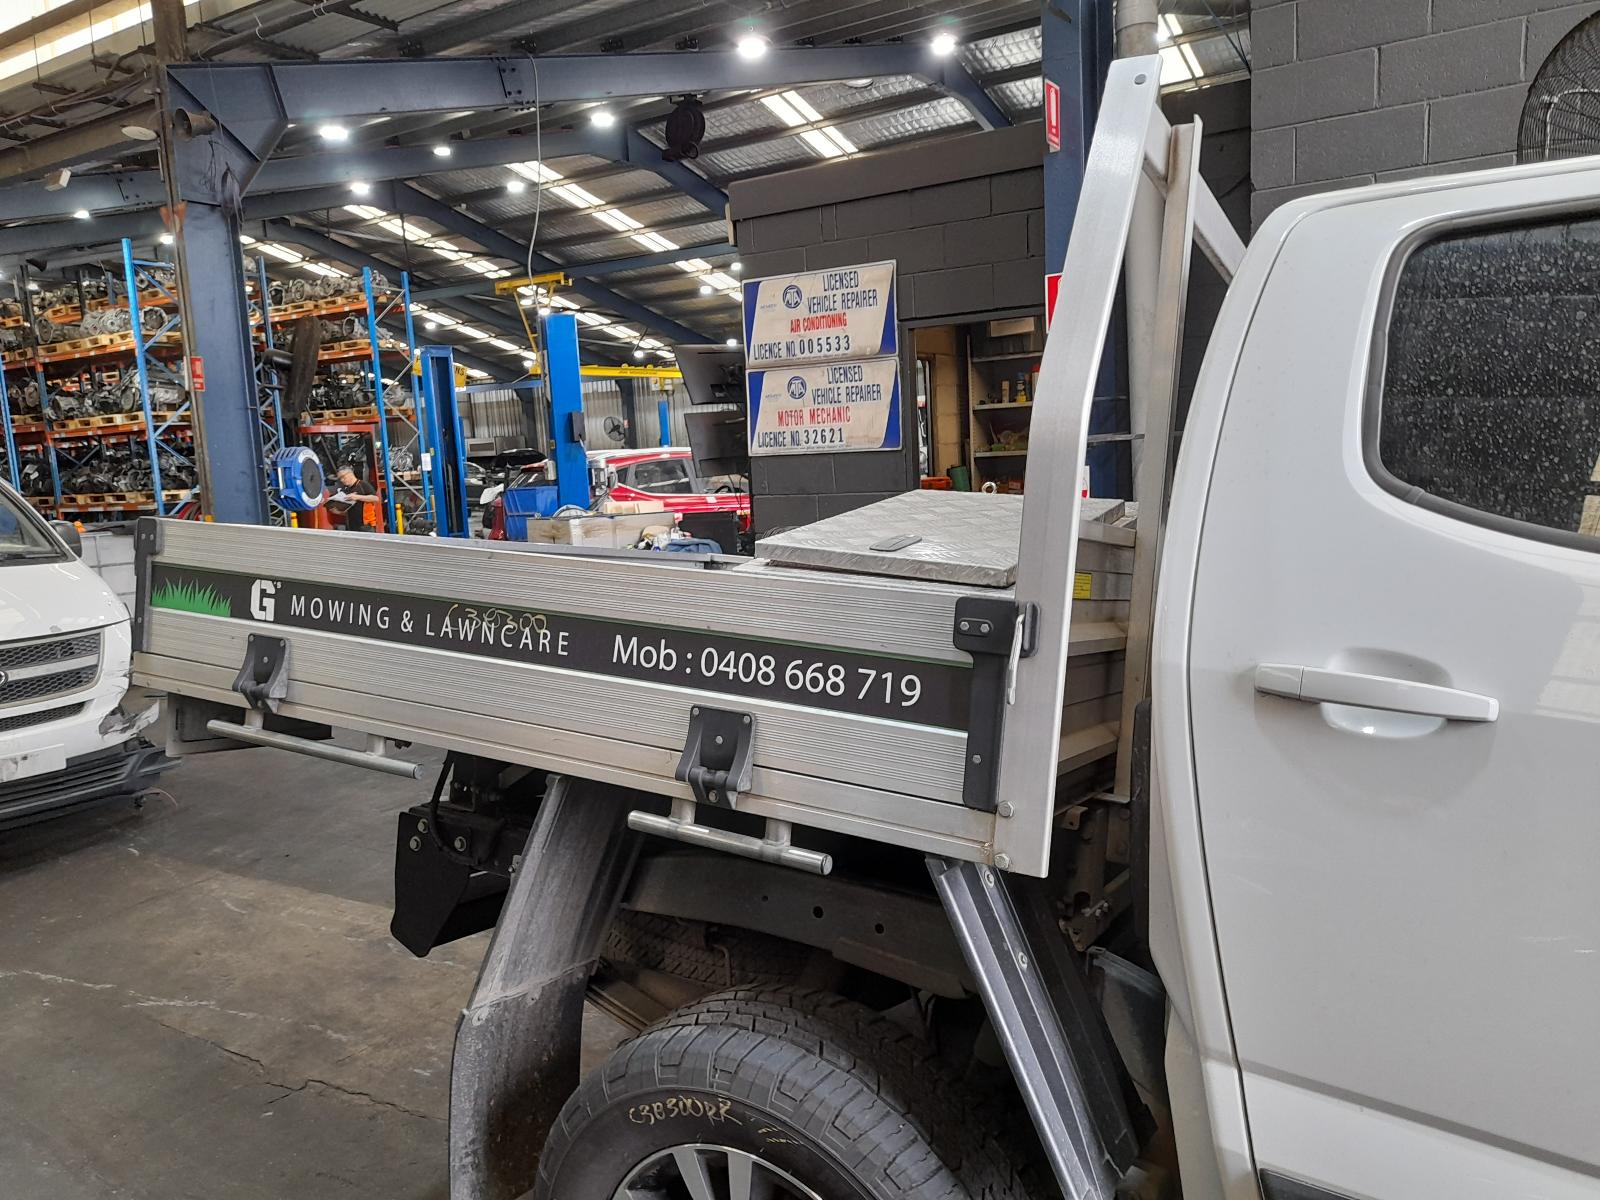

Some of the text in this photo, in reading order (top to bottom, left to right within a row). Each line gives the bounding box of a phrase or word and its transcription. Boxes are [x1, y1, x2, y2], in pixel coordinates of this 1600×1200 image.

[823, 271, 859, 292] LICENSED
[807, 289, 878, 314] VEHICLE REPAIRER
[790, 313, 848, 334] AIR CONDITIONING
[753, 342, 782, 361] LICENCE
[800, 335, 851, 355] 005533
[827, 365, 863, 385] LICENSED
[812, 384, 882, 406] VEHICLE REPAIRER
[777, 405, 851, 427] MOTOR MECHANIC
[757, 430, 787, 449] LICENCE
[804, 428, 844, 445] 32621
[290, 594, 390, 629] MOWING
[400, 610, 414, 633] &
[425, 613, 569, 656] LAWNCARE
[700, 647, 776, 686] 0408
[785, 659, 846, 697] 668
[856, 667, 922, 707] 719
